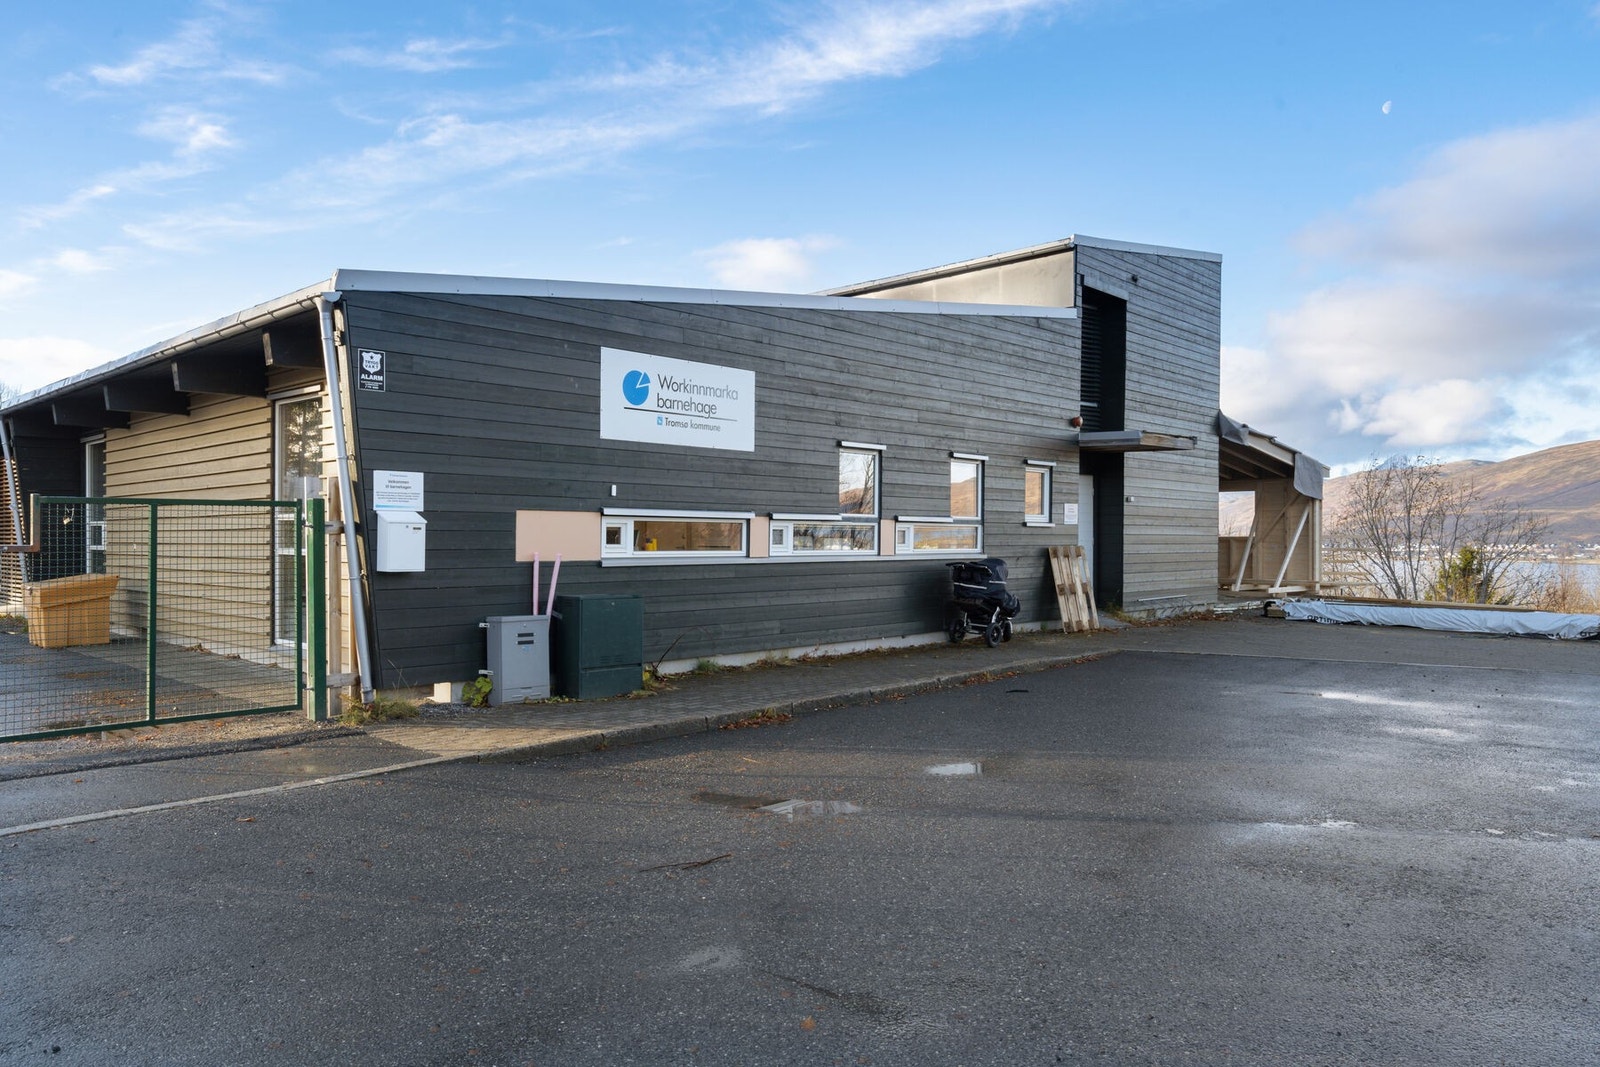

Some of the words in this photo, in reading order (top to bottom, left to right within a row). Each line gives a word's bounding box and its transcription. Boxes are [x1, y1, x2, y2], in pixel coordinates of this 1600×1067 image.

[360, 373, 383, 381] ALARM
[657, 374, 738, 400] Workinnmarka
[656, 393, 717, 419] barnehage
[665, 417, 688, 428] Tromsø
[690, 421, 720, 432] kommune
